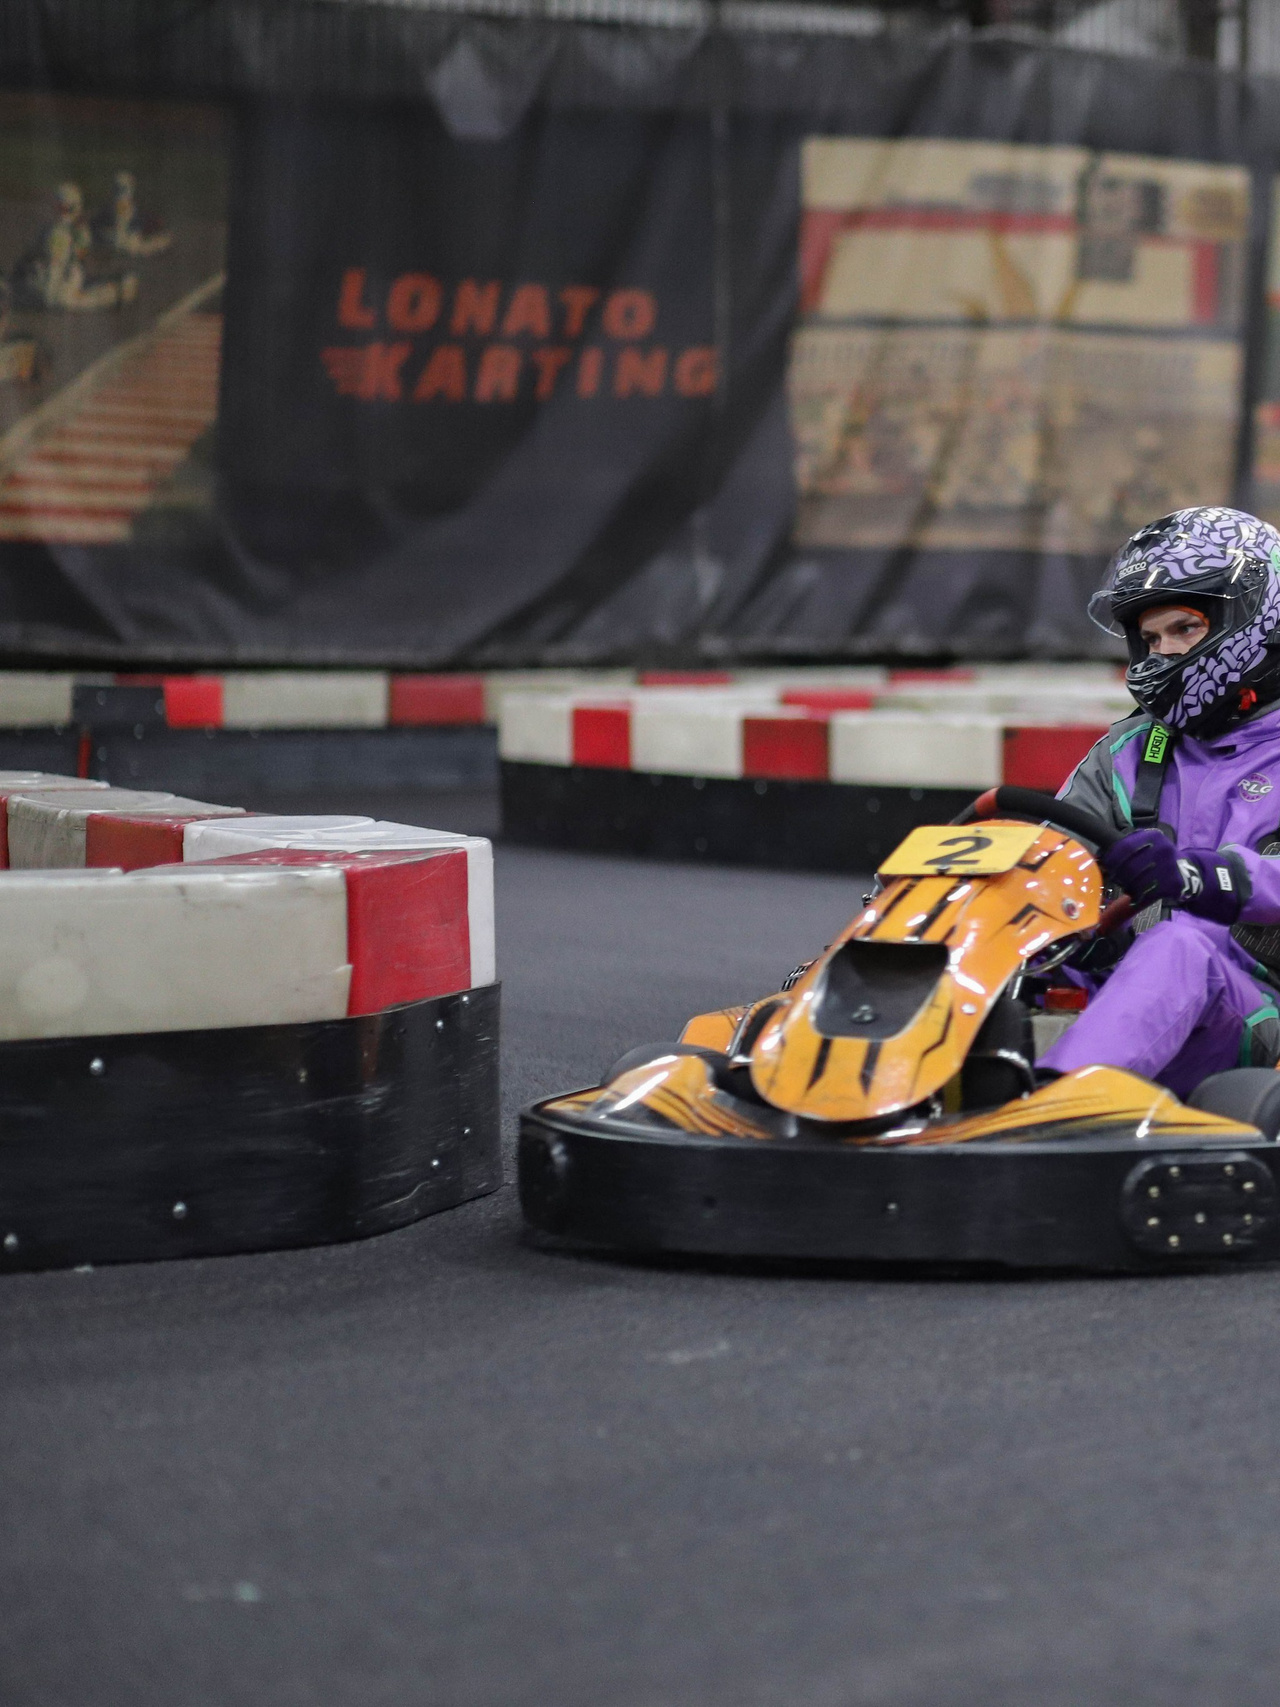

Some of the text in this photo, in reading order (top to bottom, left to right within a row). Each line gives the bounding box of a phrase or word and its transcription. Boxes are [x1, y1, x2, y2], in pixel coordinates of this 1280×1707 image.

[336, 267, 656, 340] LONATO
[352, 341, 719, 402] KARTING
[1118, 561, 1147, 580] sparco
[1237, 778, 1274, 793] RLG
[922, 836, 994, 865] 2
